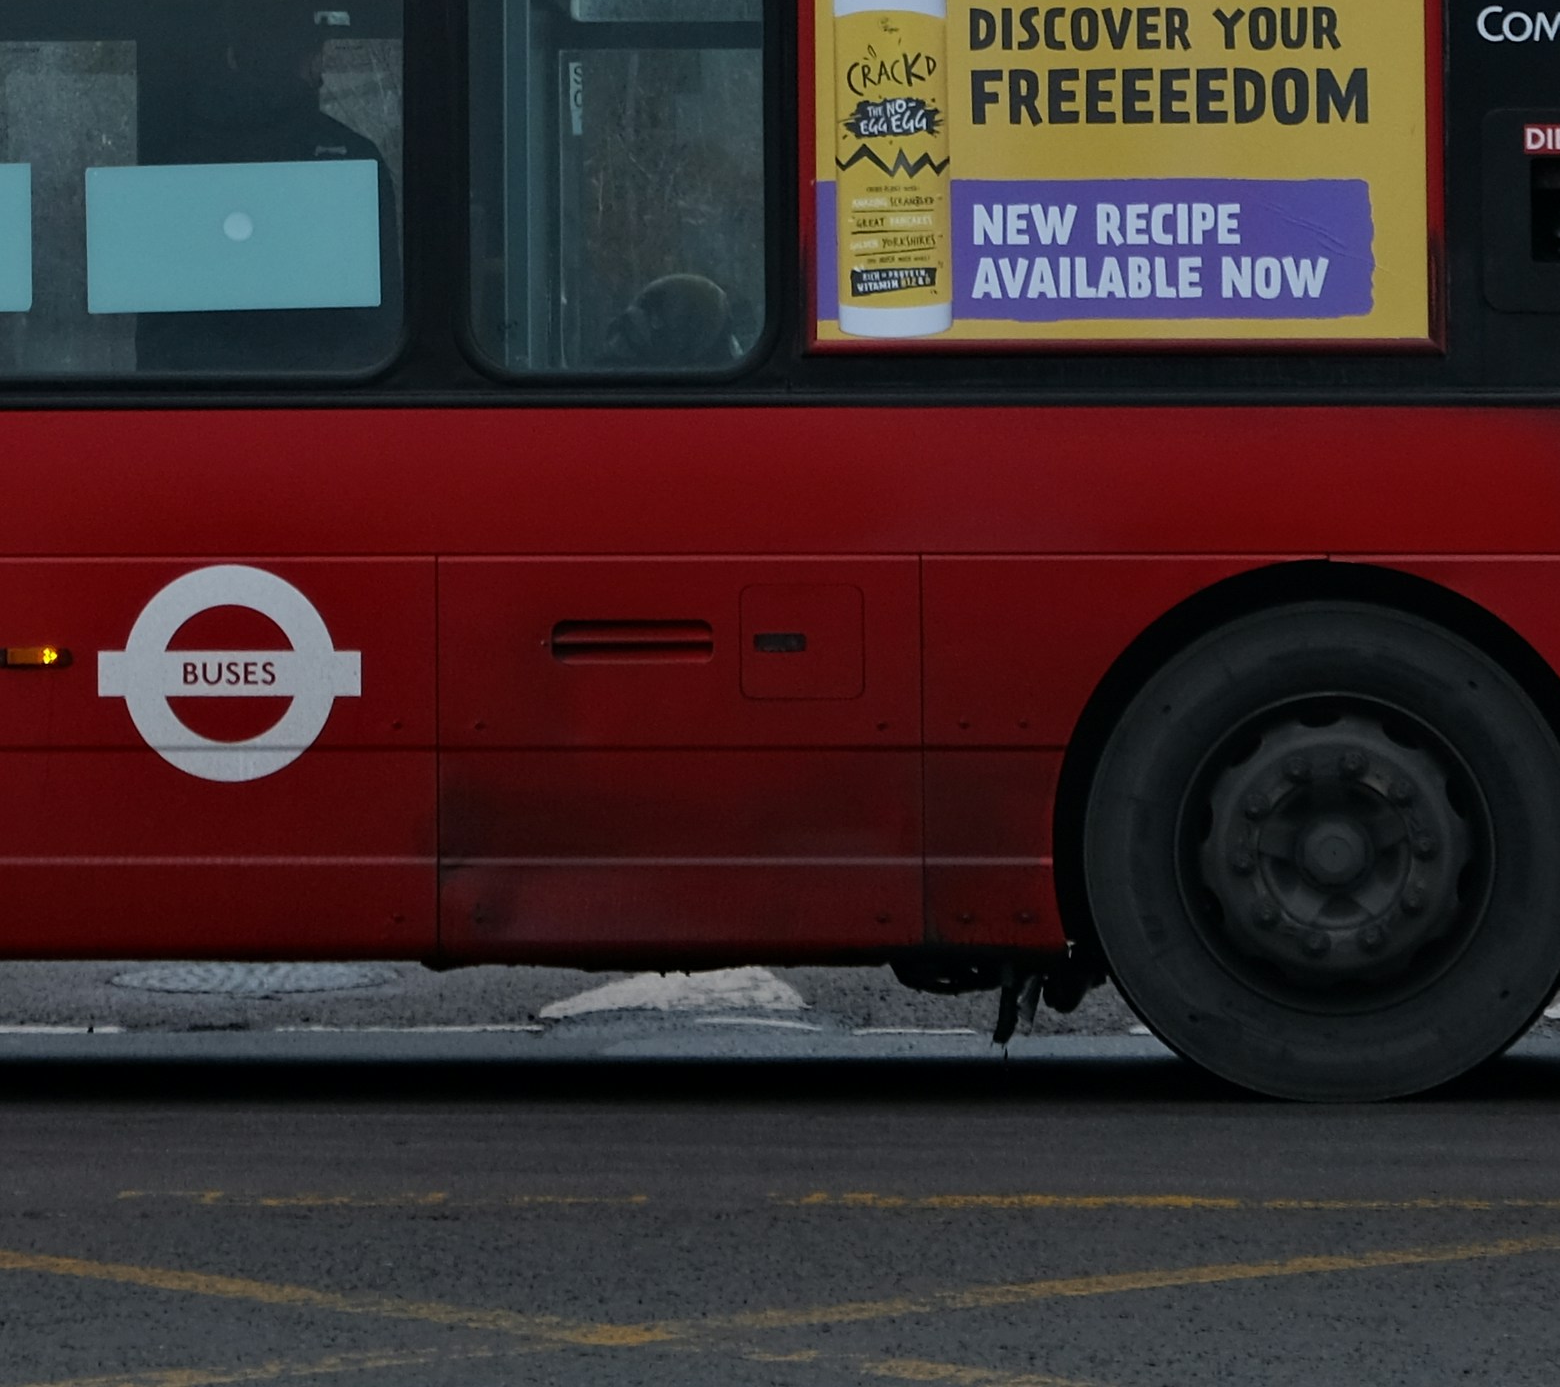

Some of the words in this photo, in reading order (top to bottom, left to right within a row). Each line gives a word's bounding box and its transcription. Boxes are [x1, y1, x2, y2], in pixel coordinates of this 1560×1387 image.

[968, 6, 1192, 53] DISCOVER
[1213, 5, 1342, 52] YOUR
[846, 52, 937, 97] CRACKD
[867, 106, 883, 118] THE
[970, 67, 1369, 127] FREEEEEDOM
[859, 118, 887, 135] EGG
[891, 109, 928, 133] EGG
[972, 202, 1078, 245] NEW
[1096, 203, 1241, 245] RECIPE
[971, 256, 1207, 299] AVAILABLE
[1221, 256, 1329, 298] NOW
[182, 661, 276, 686] BUSES
